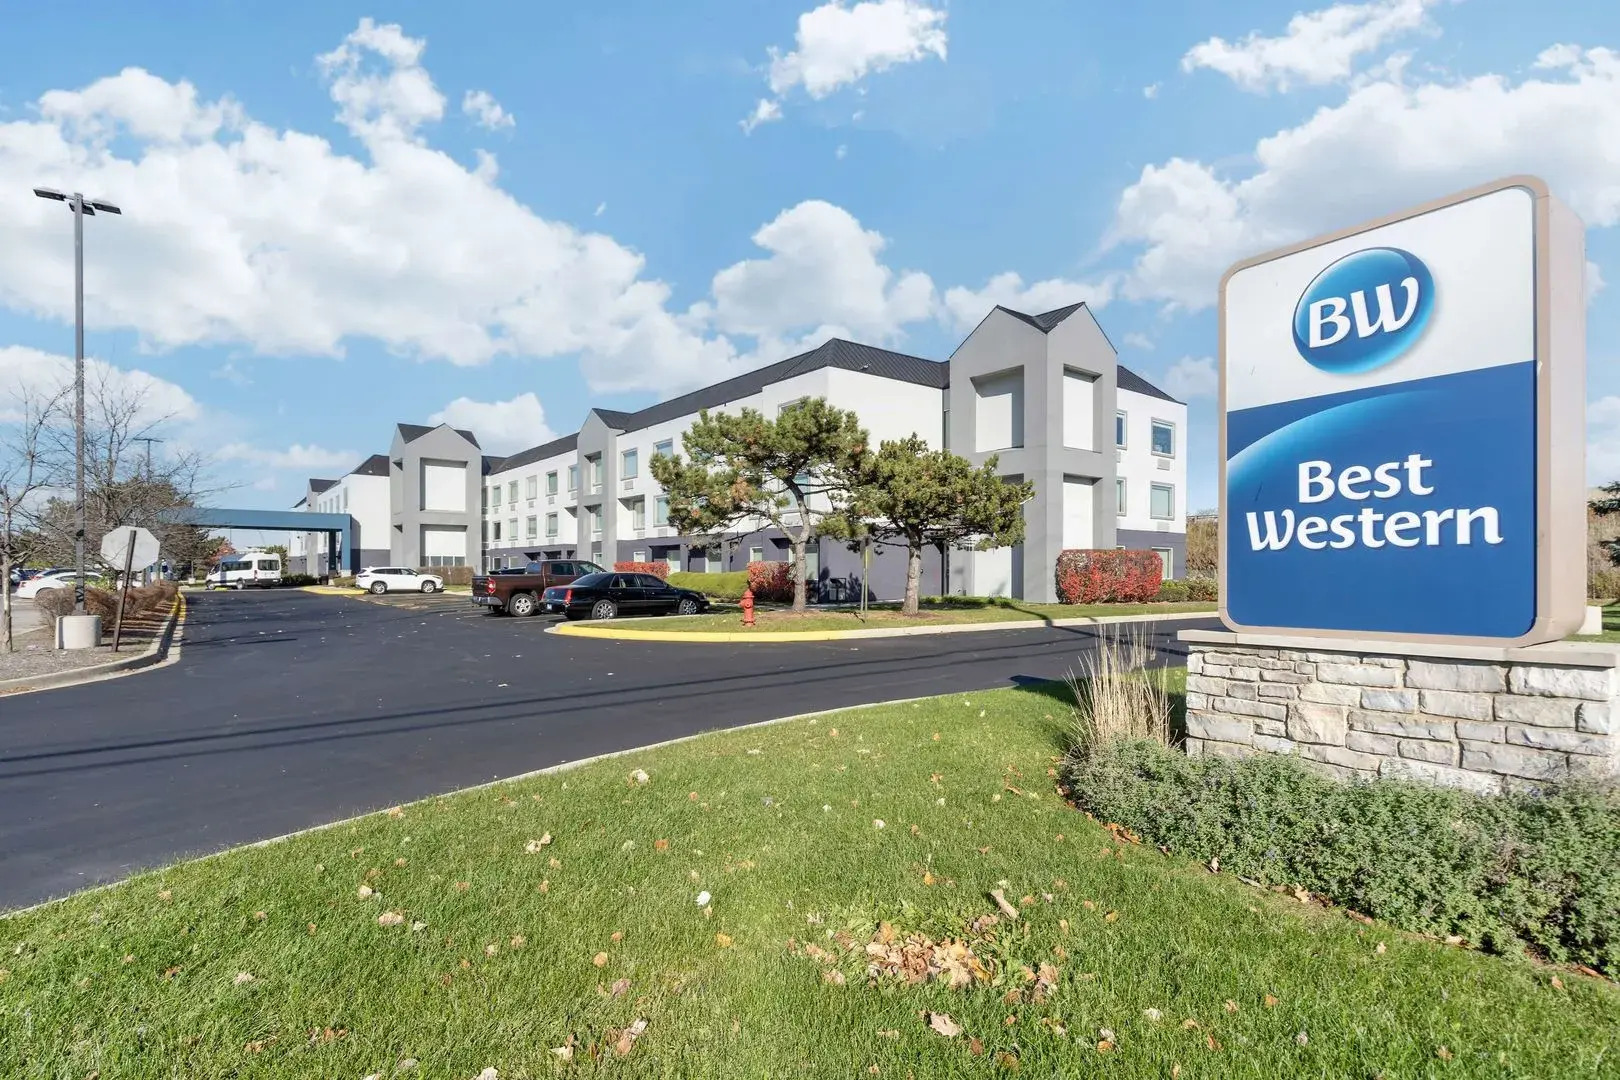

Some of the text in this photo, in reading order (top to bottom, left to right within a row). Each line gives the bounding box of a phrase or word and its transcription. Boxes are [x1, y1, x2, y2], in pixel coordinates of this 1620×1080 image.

[1309, 276, 1419, 348] BW
[1298, 454, 1434, 504] Best
[1246, 506, 1504, 551] Western
